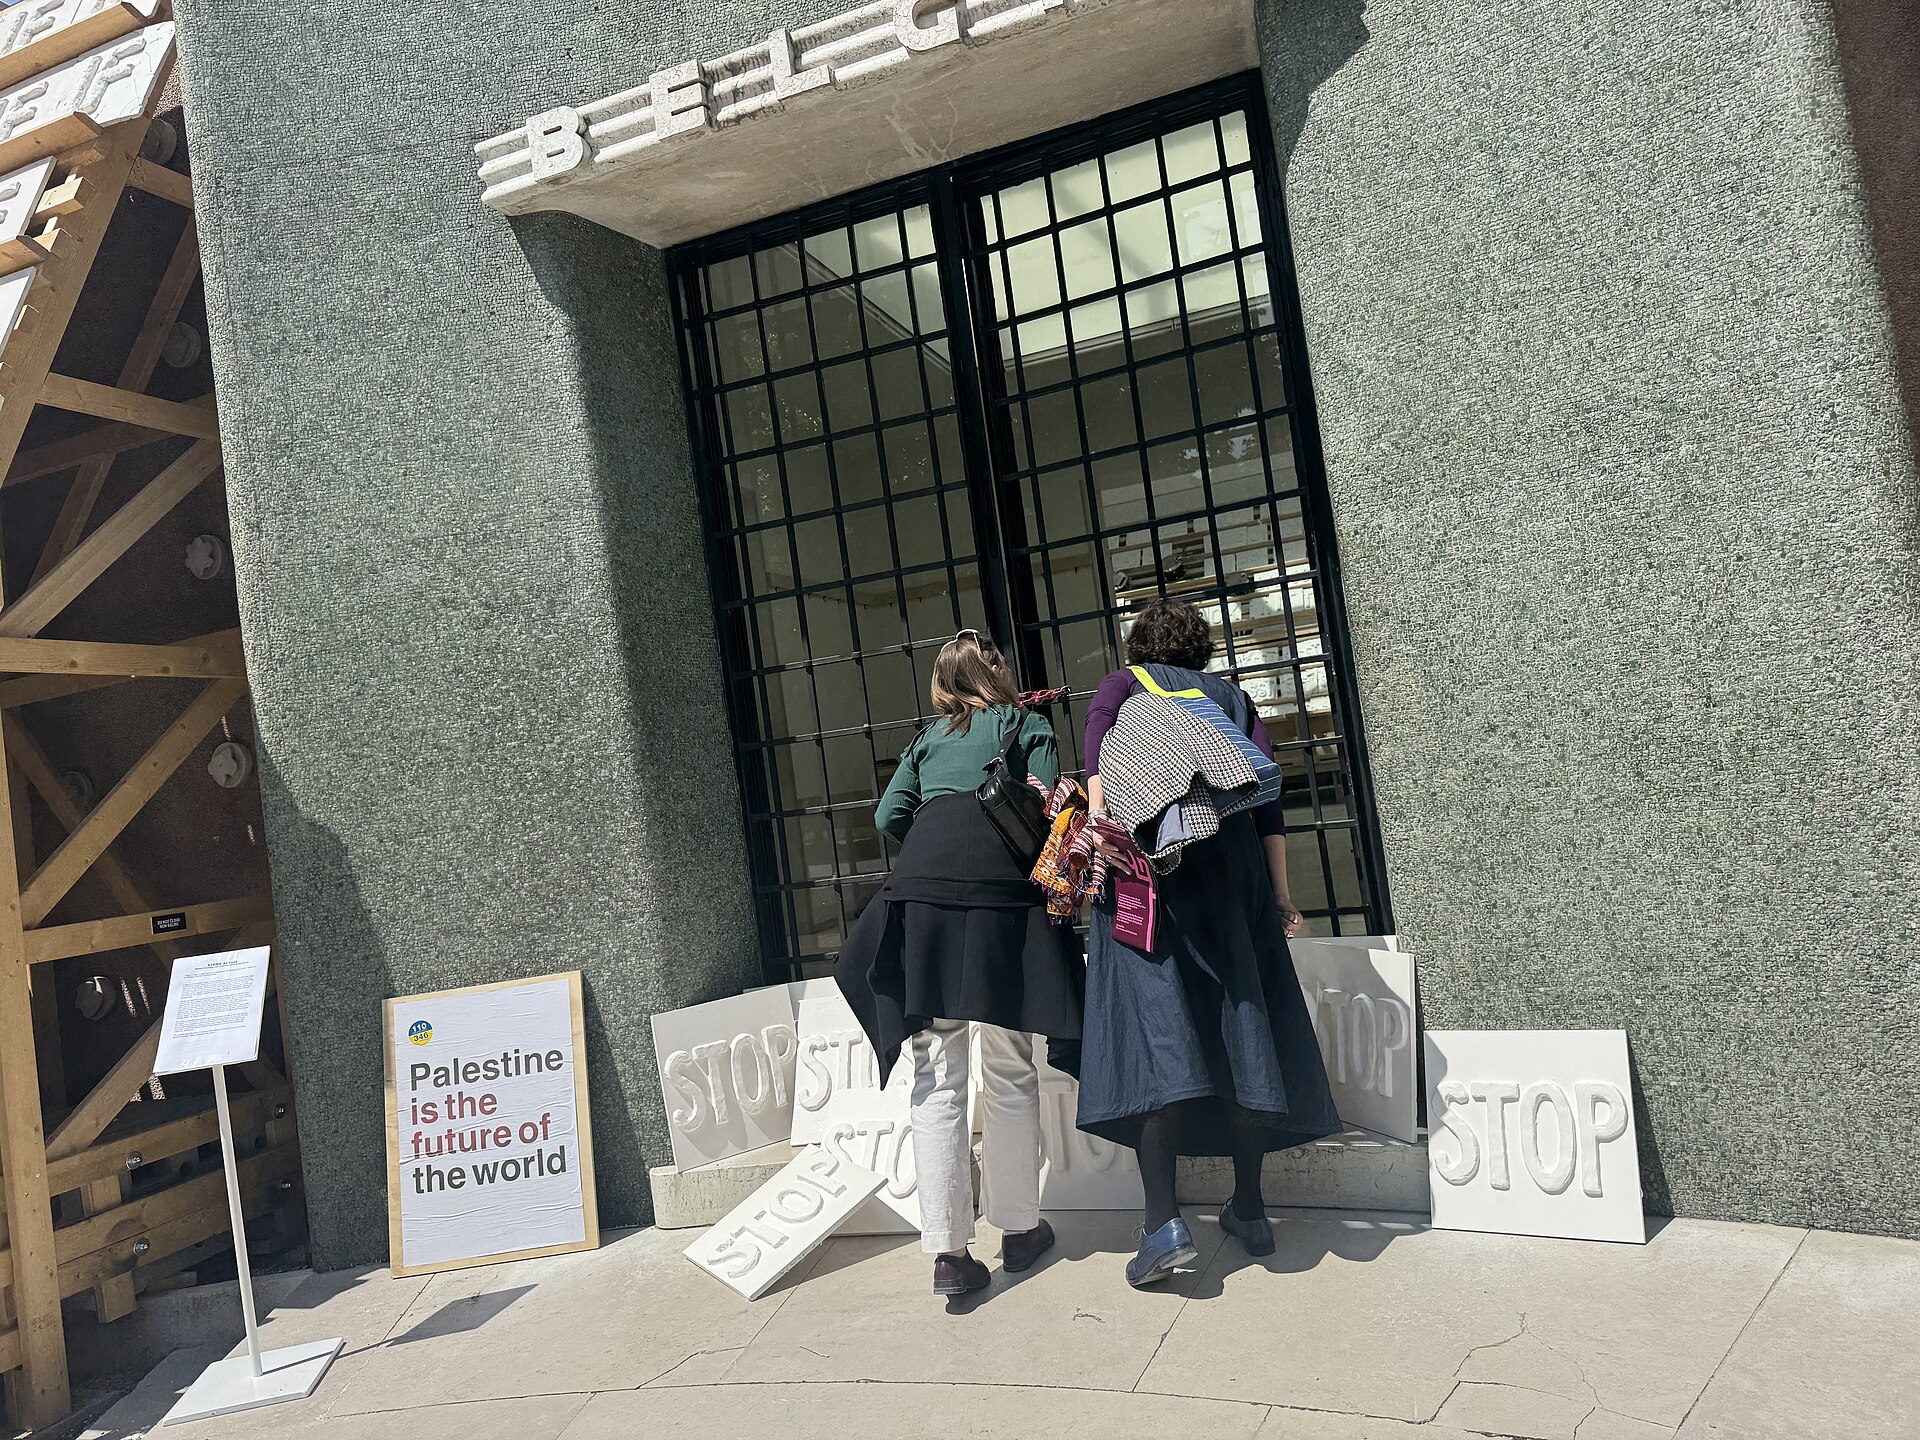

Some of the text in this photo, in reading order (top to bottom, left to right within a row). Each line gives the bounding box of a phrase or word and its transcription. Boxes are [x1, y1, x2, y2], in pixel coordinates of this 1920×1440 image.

[526, 0, 1064, 182] BELG
[412, 1022, 427, 1032] 110
[1300, 983, 1409, 1098] TOP
[411, 1048, 564, 1091] Palestine
[411, 1091, 498, 1126] is the
[664, 1023, 798, 1133] STOP
[411, 1112, 551, 1159] future of
[413, 1145, 567, 1195] the world
[1433, 1080, 1628, 1199] STOP
[706, 1148, 848, 1279] STOP
